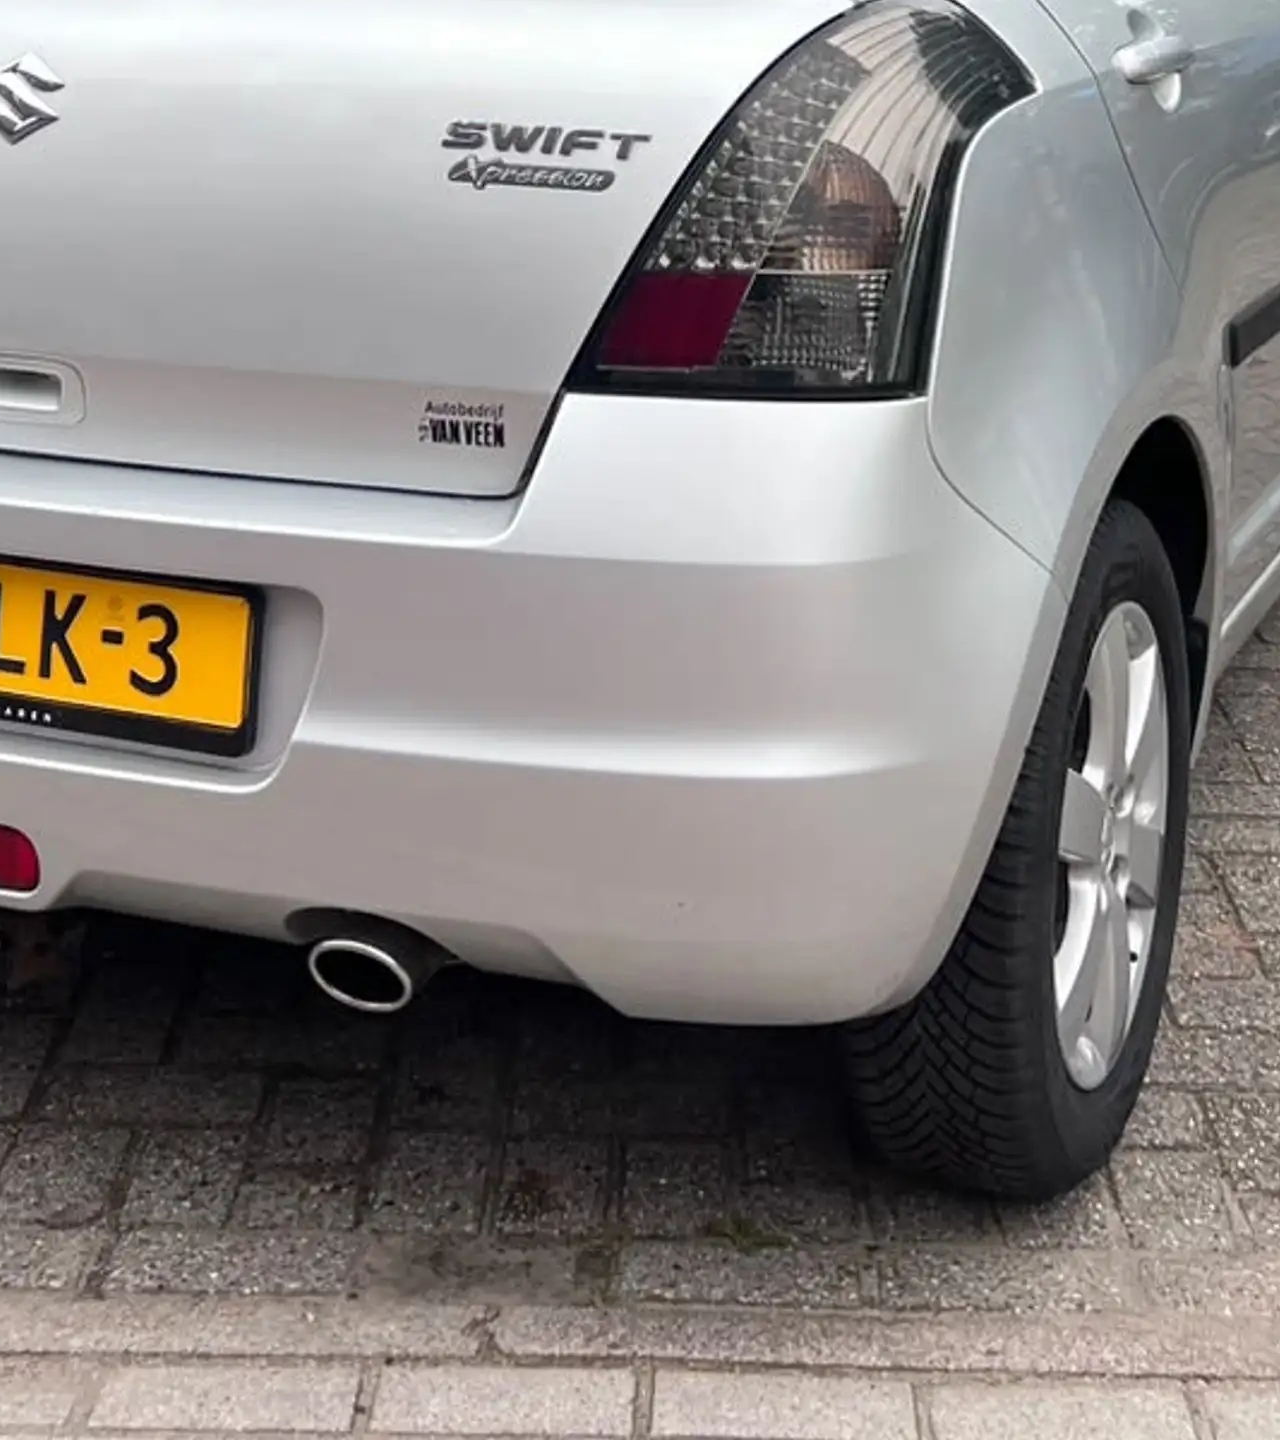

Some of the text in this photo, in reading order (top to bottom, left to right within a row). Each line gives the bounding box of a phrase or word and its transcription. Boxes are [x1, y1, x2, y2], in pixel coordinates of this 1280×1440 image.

[441, 121, 653, 162] SWIFT
[429, 418, 506, 448] VAN VEEN
